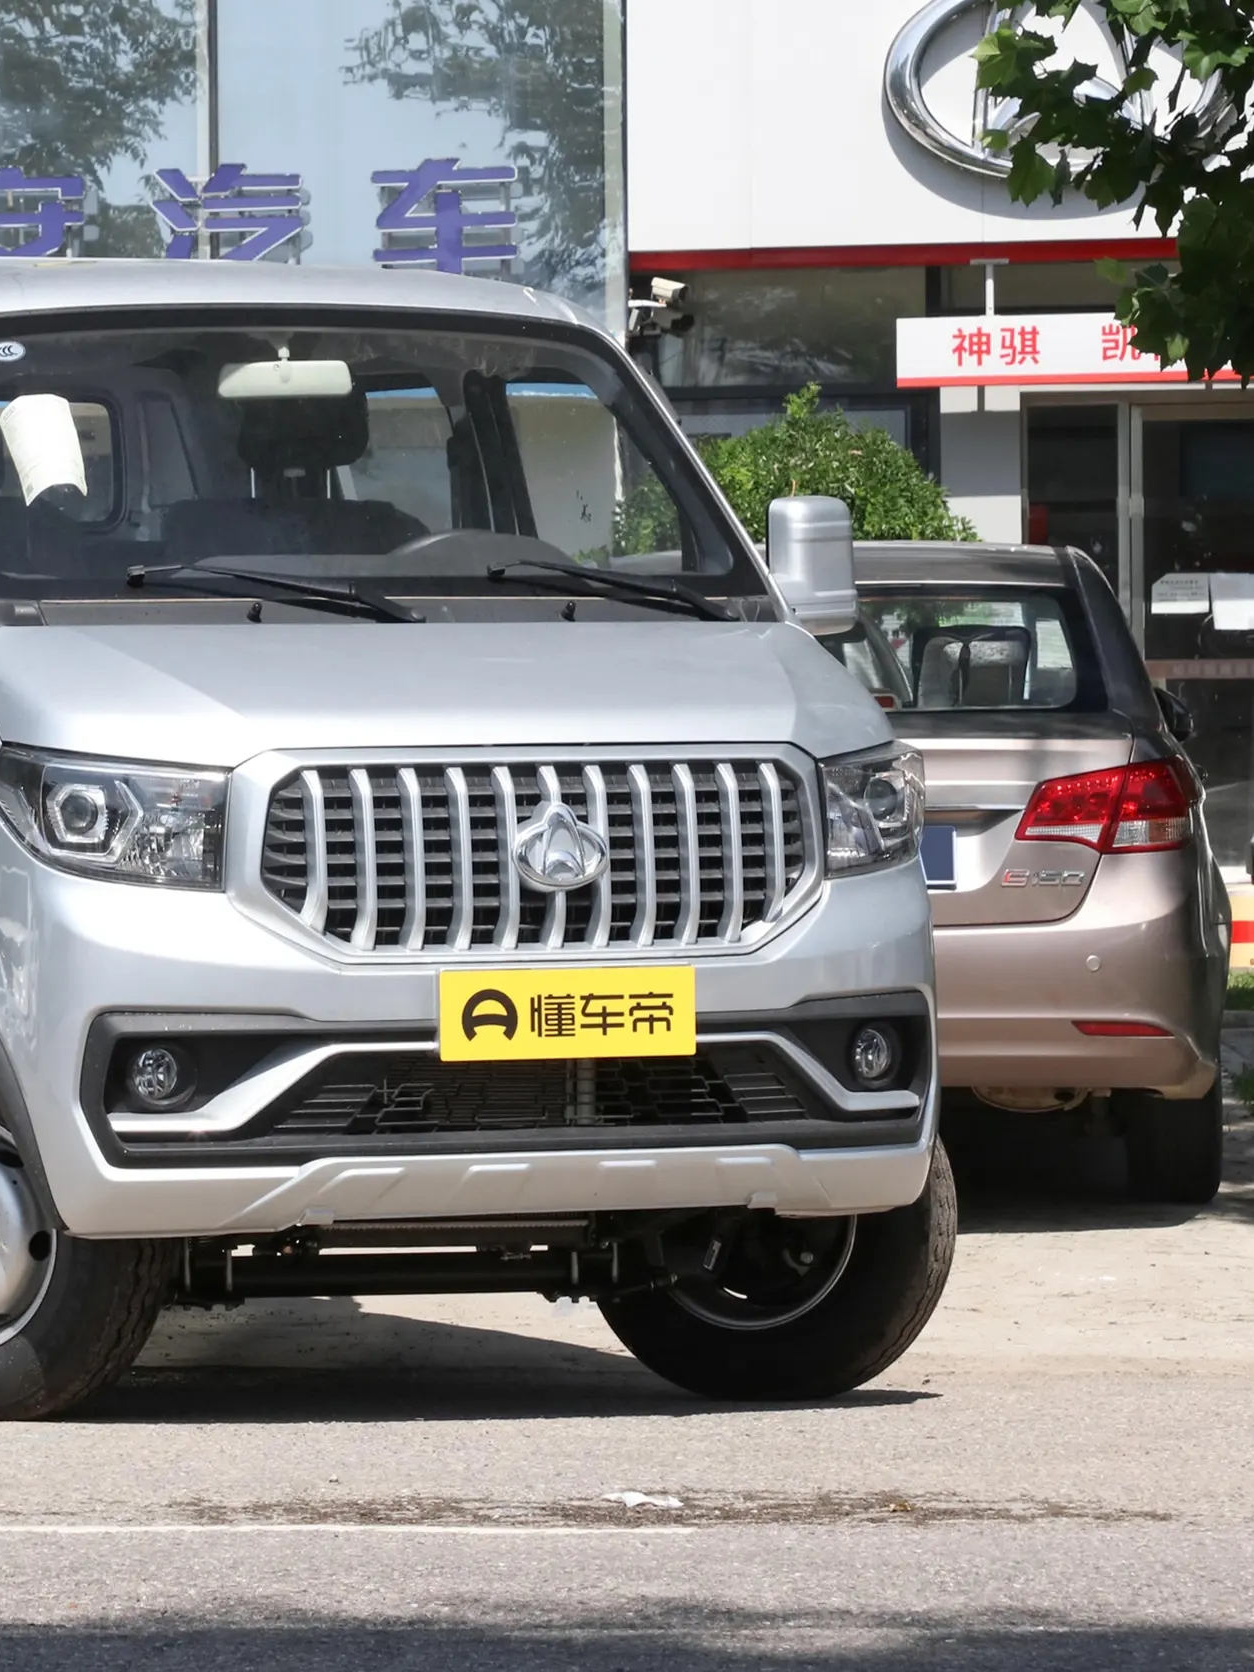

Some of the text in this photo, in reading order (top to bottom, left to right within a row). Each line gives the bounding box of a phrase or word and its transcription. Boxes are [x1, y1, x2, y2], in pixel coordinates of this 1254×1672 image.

[952, 326, 1040, 367] 神骐
[530, 991, 674, 1038] 懂车帝
